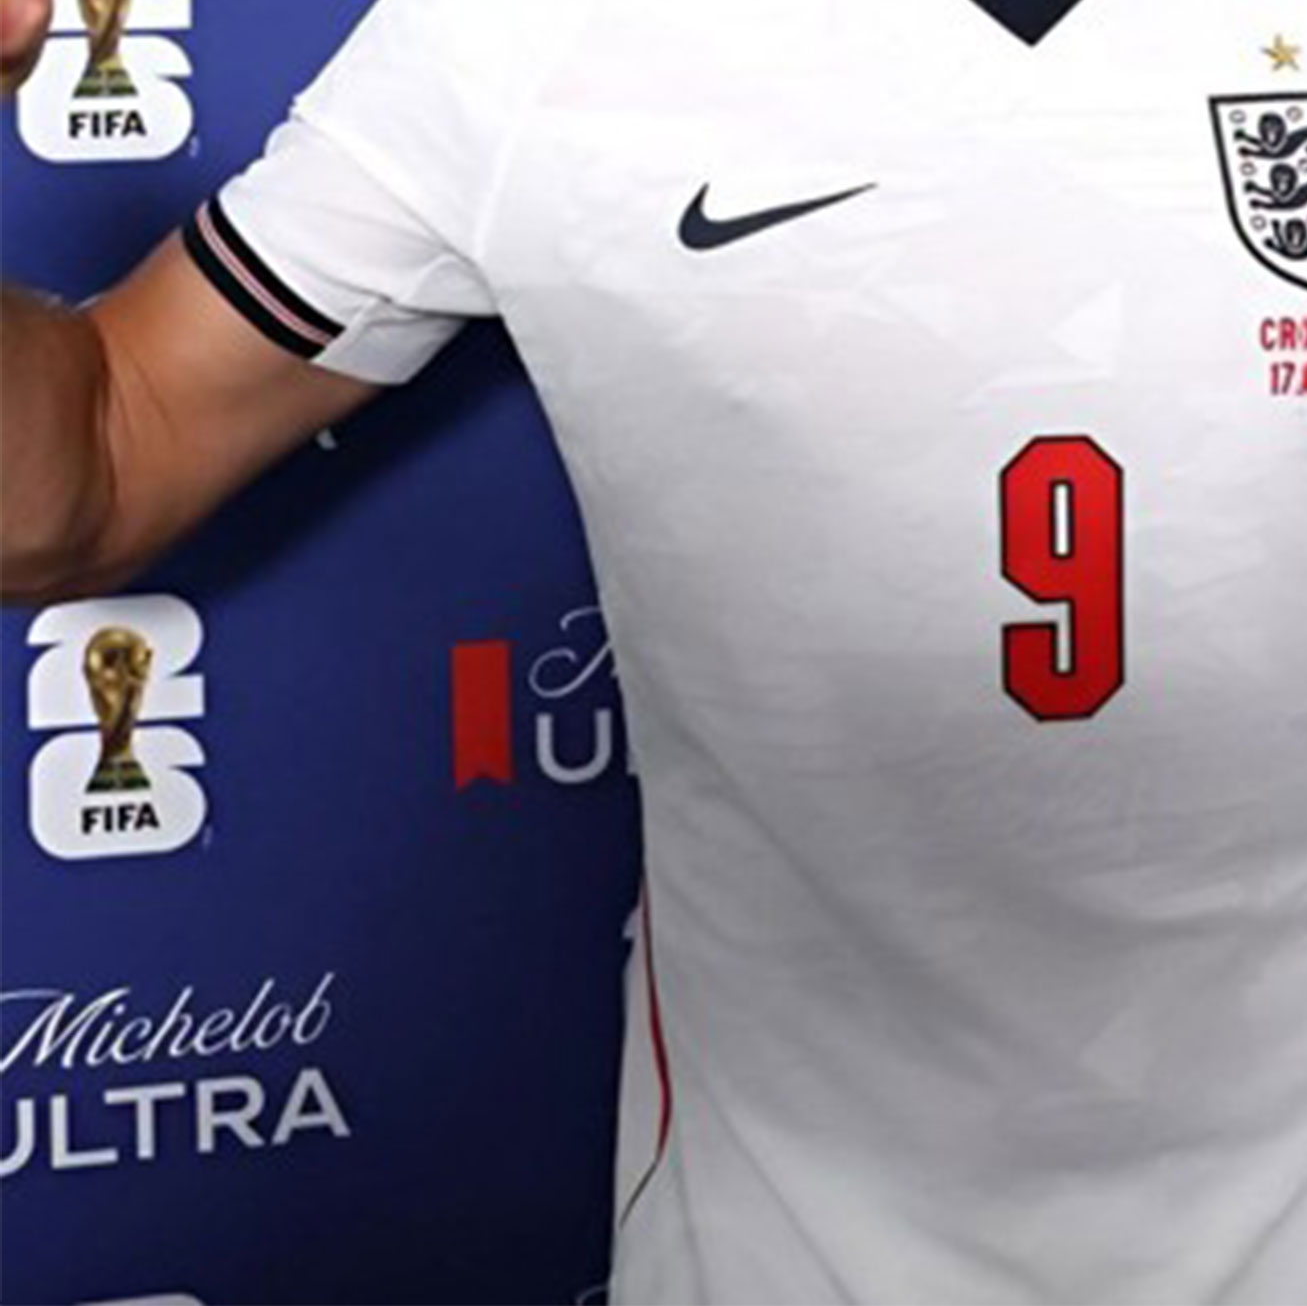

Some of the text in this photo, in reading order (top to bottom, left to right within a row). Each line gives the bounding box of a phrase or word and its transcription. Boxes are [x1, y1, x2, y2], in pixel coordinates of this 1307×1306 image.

[68, 109, 147, 140] FIFA
[1000, 436, 1125, 722] 9
[81, 801, 160, 836] FIFA
[0, 972, 335, 1072] Michelob
